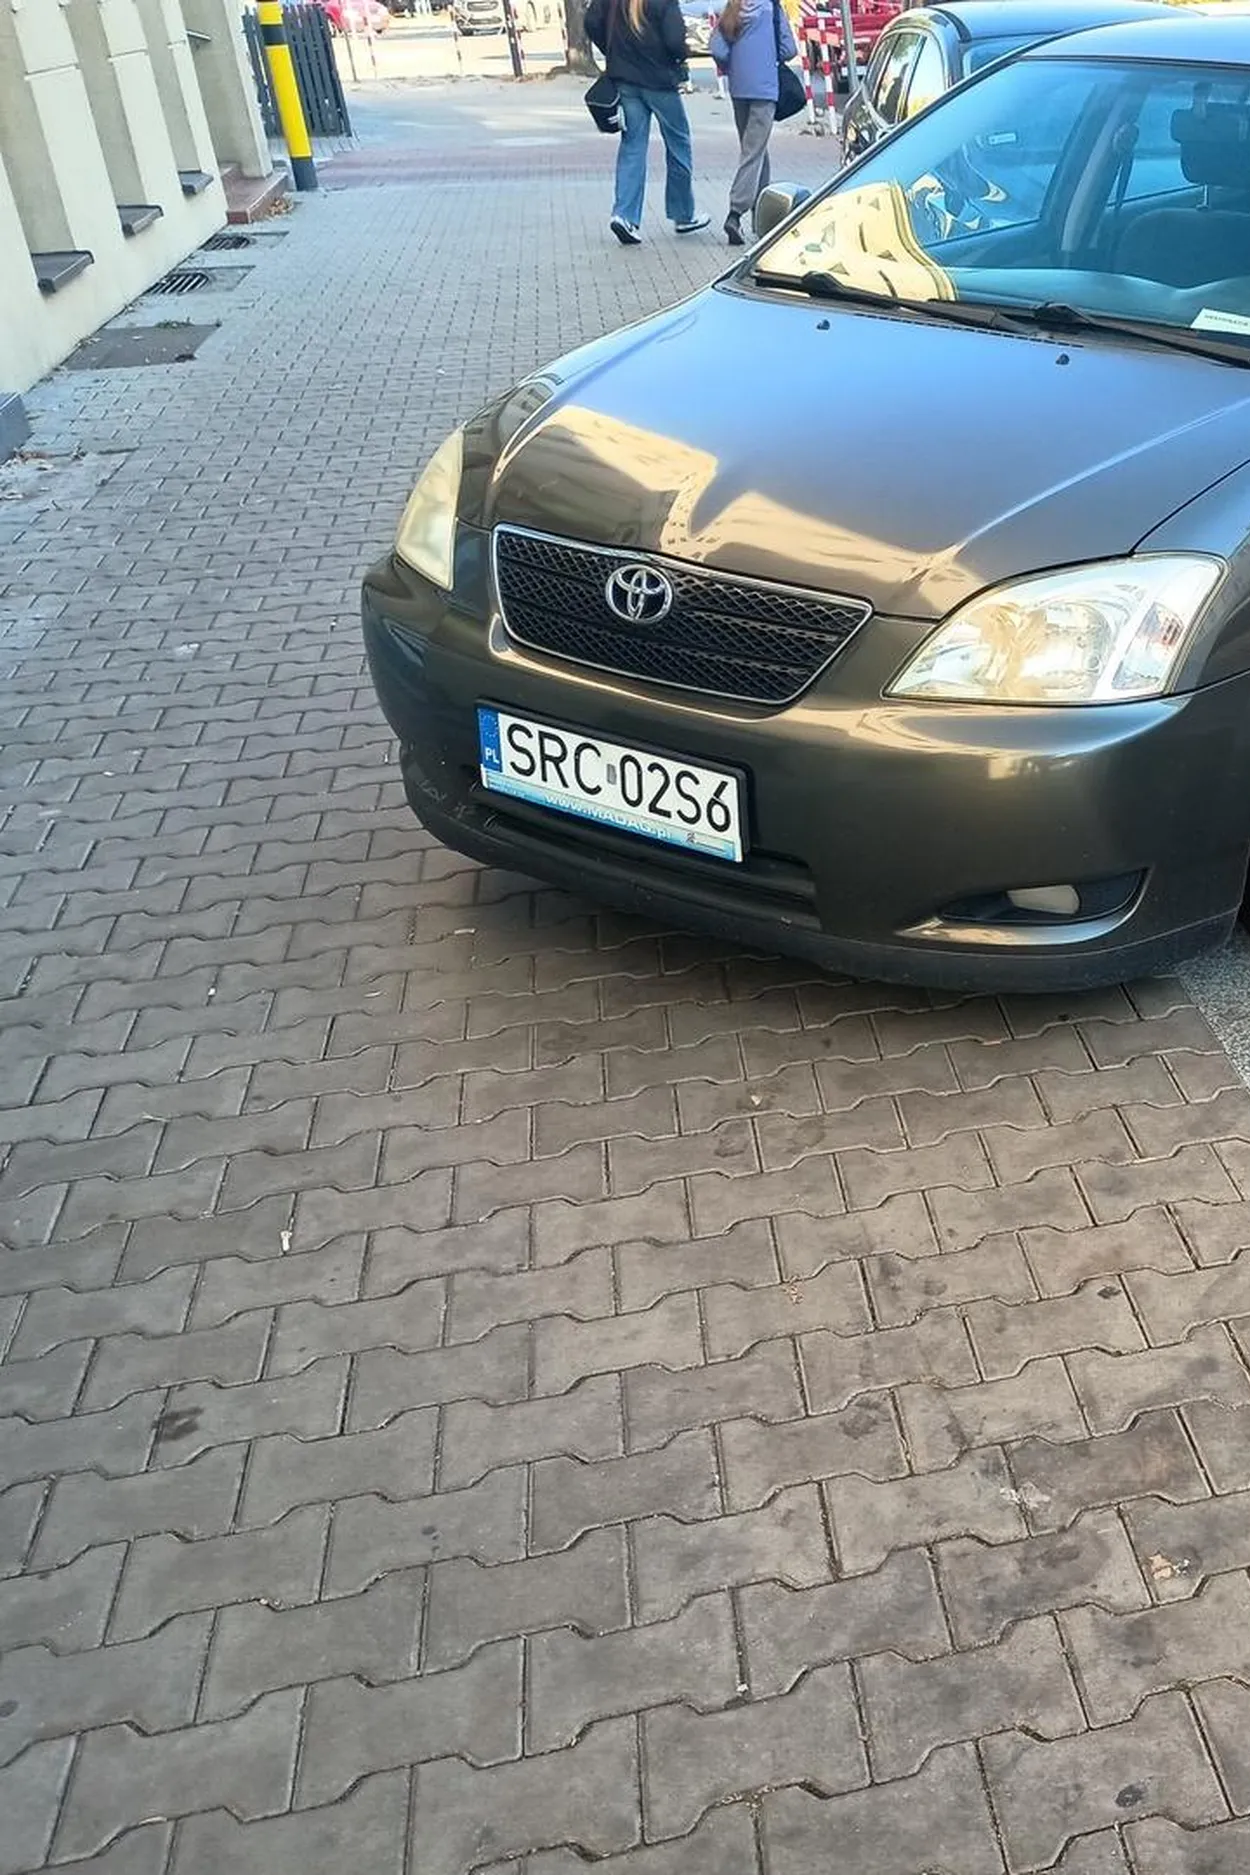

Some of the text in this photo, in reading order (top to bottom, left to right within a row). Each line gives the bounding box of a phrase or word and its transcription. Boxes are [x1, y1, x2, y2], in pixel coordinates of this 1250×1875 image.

[484, 748, 500, 765] PL
[506, 723, 731, 833] SRC 02S6
